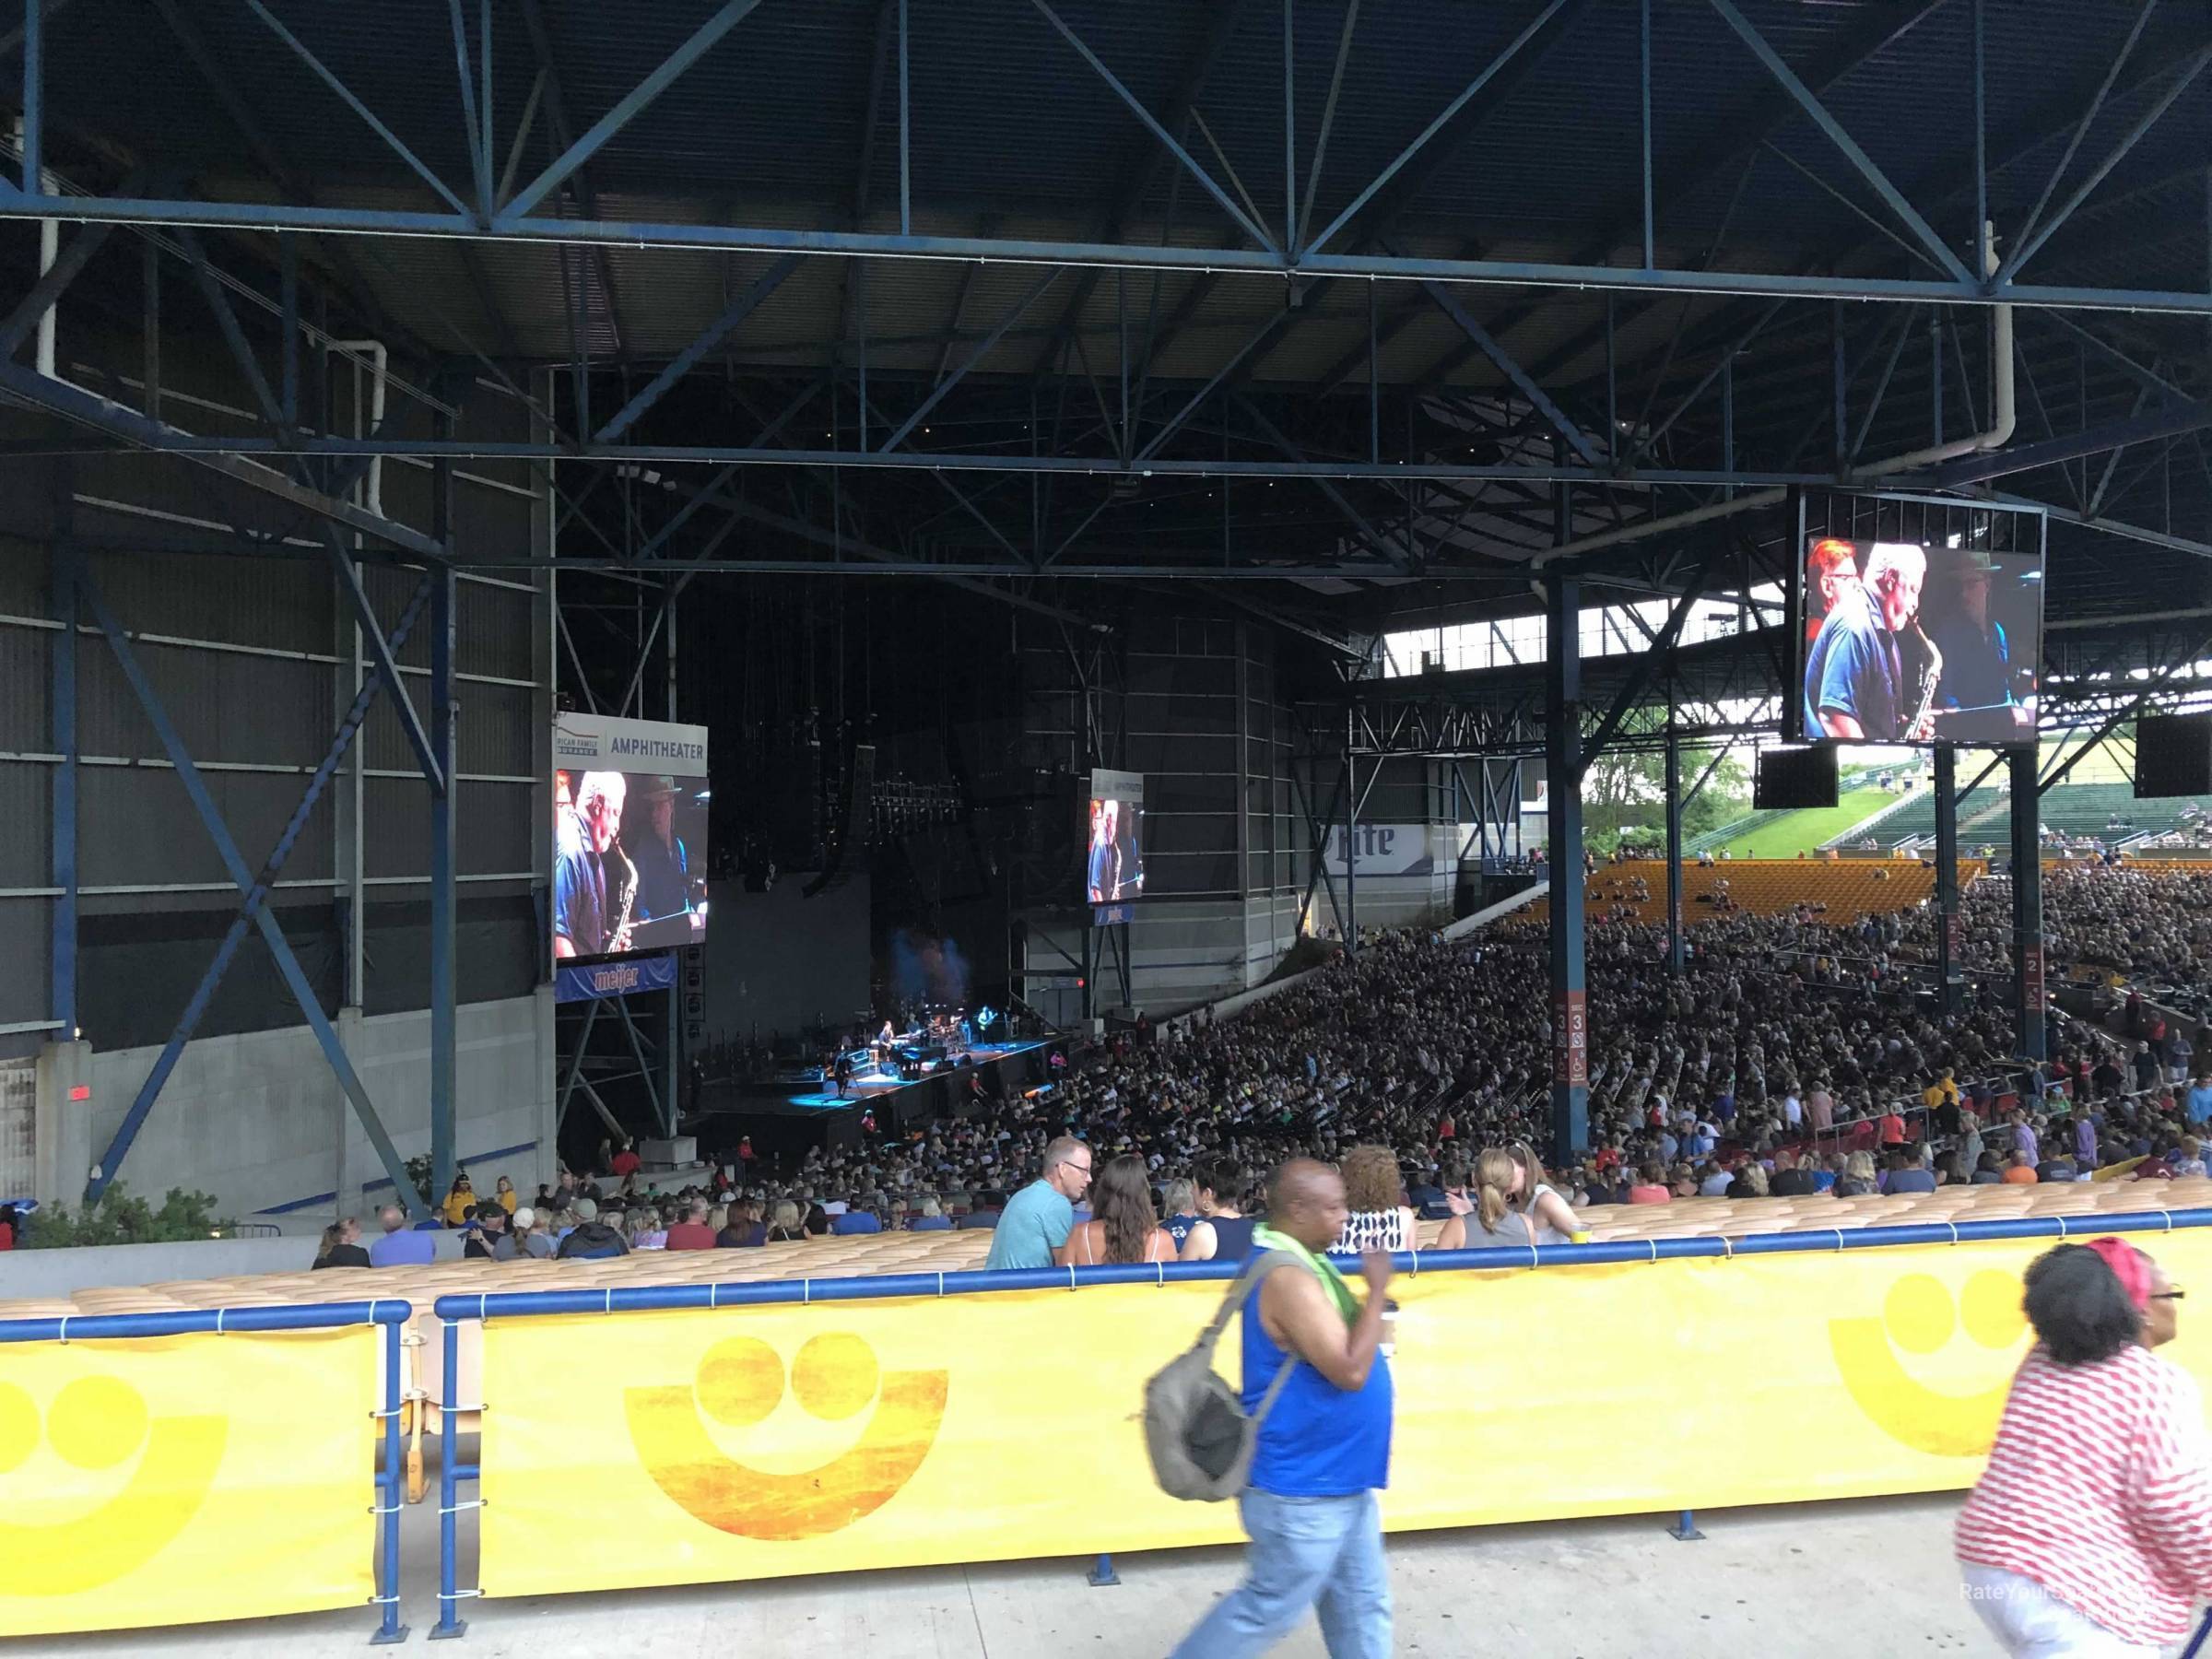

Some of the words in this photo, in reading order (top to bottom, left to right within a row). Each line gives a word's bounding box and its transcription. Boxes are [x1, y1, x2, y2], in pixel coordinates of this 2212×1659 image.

[611, 736, 703, 759] AMPHITHEATER
[1335, 819, 1394, 865] Lite
[2028, 959, 2037, 972] 2
[594, 962, 639, 994] meijer
[1571, 1004, 1583, 1012] SEC
[1558, 1014, 1566, 1030] 3
[1572, 1014, 1583, 1030] 3
